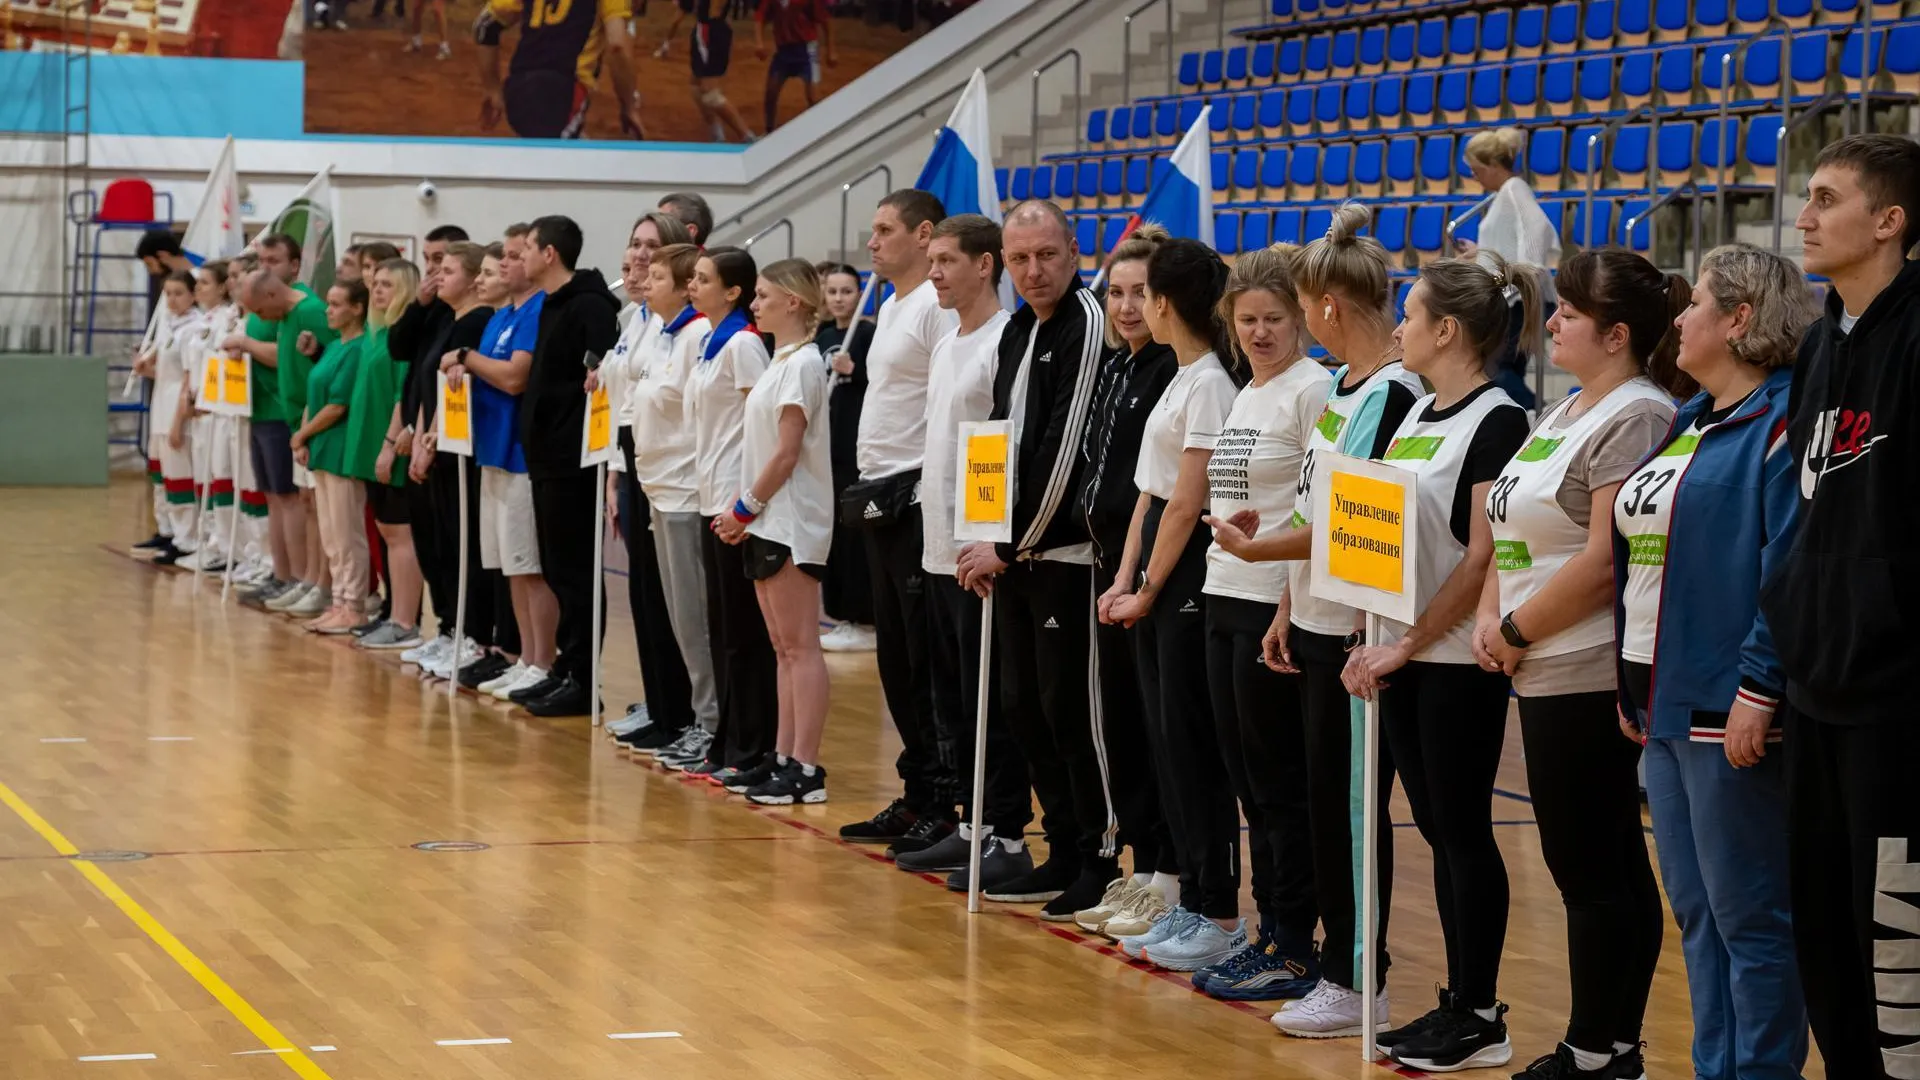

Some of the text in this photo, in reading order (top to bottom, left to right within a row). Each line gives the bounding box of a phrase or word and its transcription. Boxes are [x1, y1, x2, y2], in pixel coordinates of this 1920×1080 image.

[968, 459, 1005, 478] Управление
[977, 486, 995, 504] МКД
[1335, 493, 1401, 525] Управление
[1487, 475, 1520, 524] 38
[1624, 469, 1676, 517] 32
[1332, 527, 1401, 559] образования
